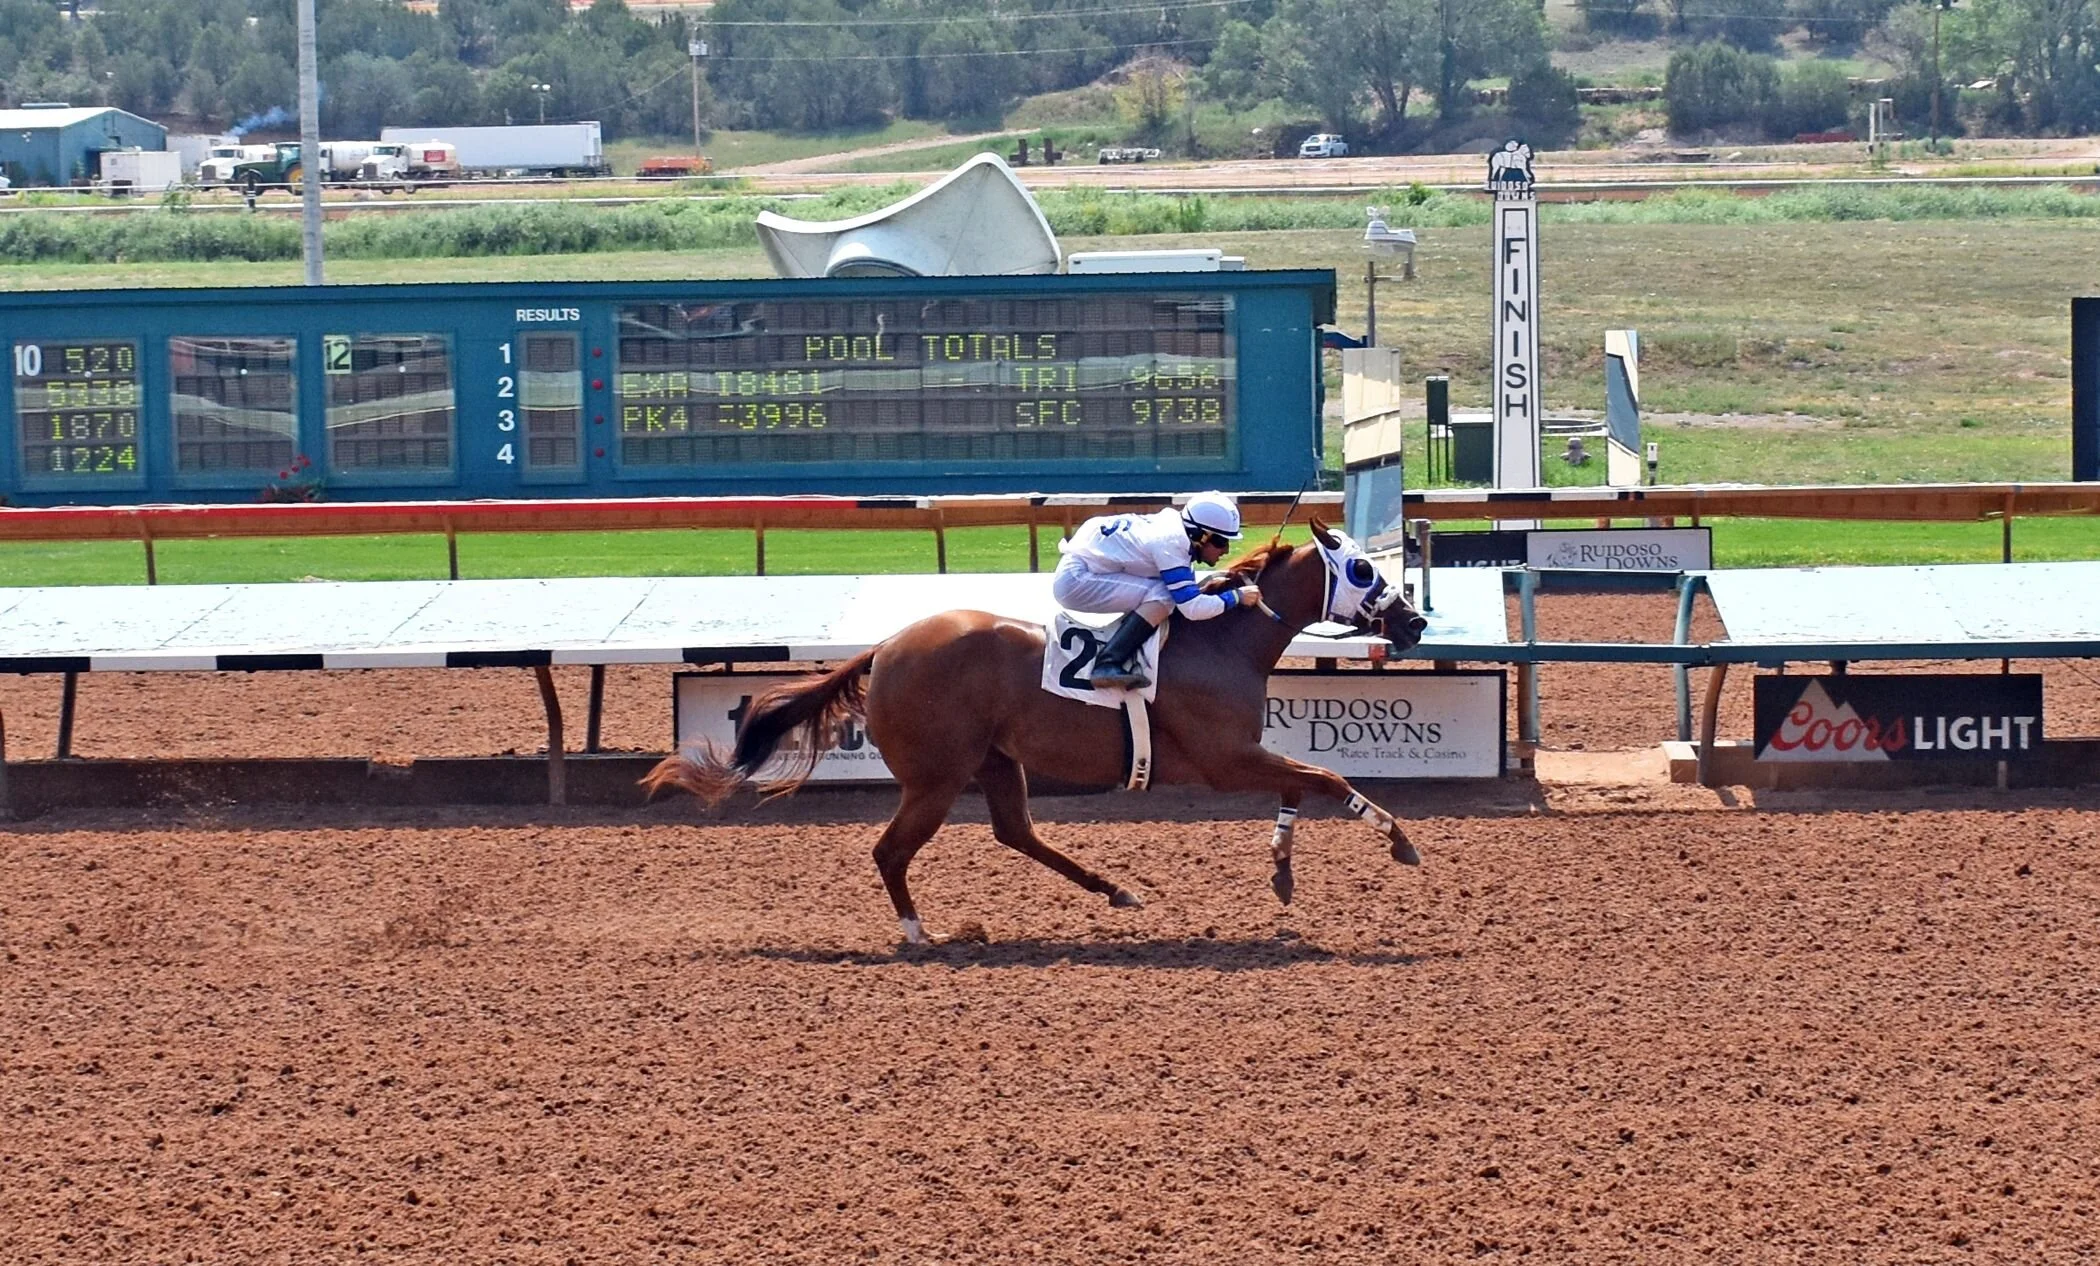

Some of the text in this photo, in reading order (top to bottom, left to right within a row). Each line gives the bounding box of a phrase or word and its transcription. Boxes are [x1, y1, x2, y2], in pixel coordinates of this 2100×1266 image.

[516, 308, 581, 322] RESULTS
[1504, 237, 1528, 418] FINISH
[14, 344, 42, 376] 10
[66, 347, 133, 373] 520
[325, 340, 351, 371] 12
[499, 343, 512, 364] 1
[805, 334, 1057, 361] POOL TOTALS
[498, 377, 515, 398] 2
[623, 373, 688, 398] EXA
[1015, 366, 1078, 392] TRI
[51, 412, 135, 439] 1870
[498, 410, 515, 431] 3
[623, 406, 689, 431] PK4
[1016, 398, 1220, 427] SFC 9738
[52, 446, 136, 472] 1224
[496, 444, 515, 464] 4
[1580, 543, 1662, 562] RUIDOSO
[1605, 555, 1679, 570] DOWNS
[1060, 627, 1098, 690] 2
[1265, 697, 1413, 729] RUIDOSO
[1308, 721, 1442, 752] DOWNS
[1769, 701, 2036, 752] Coors LIGHT
[1340, 747, 1467, 759] Race Track & Casino
